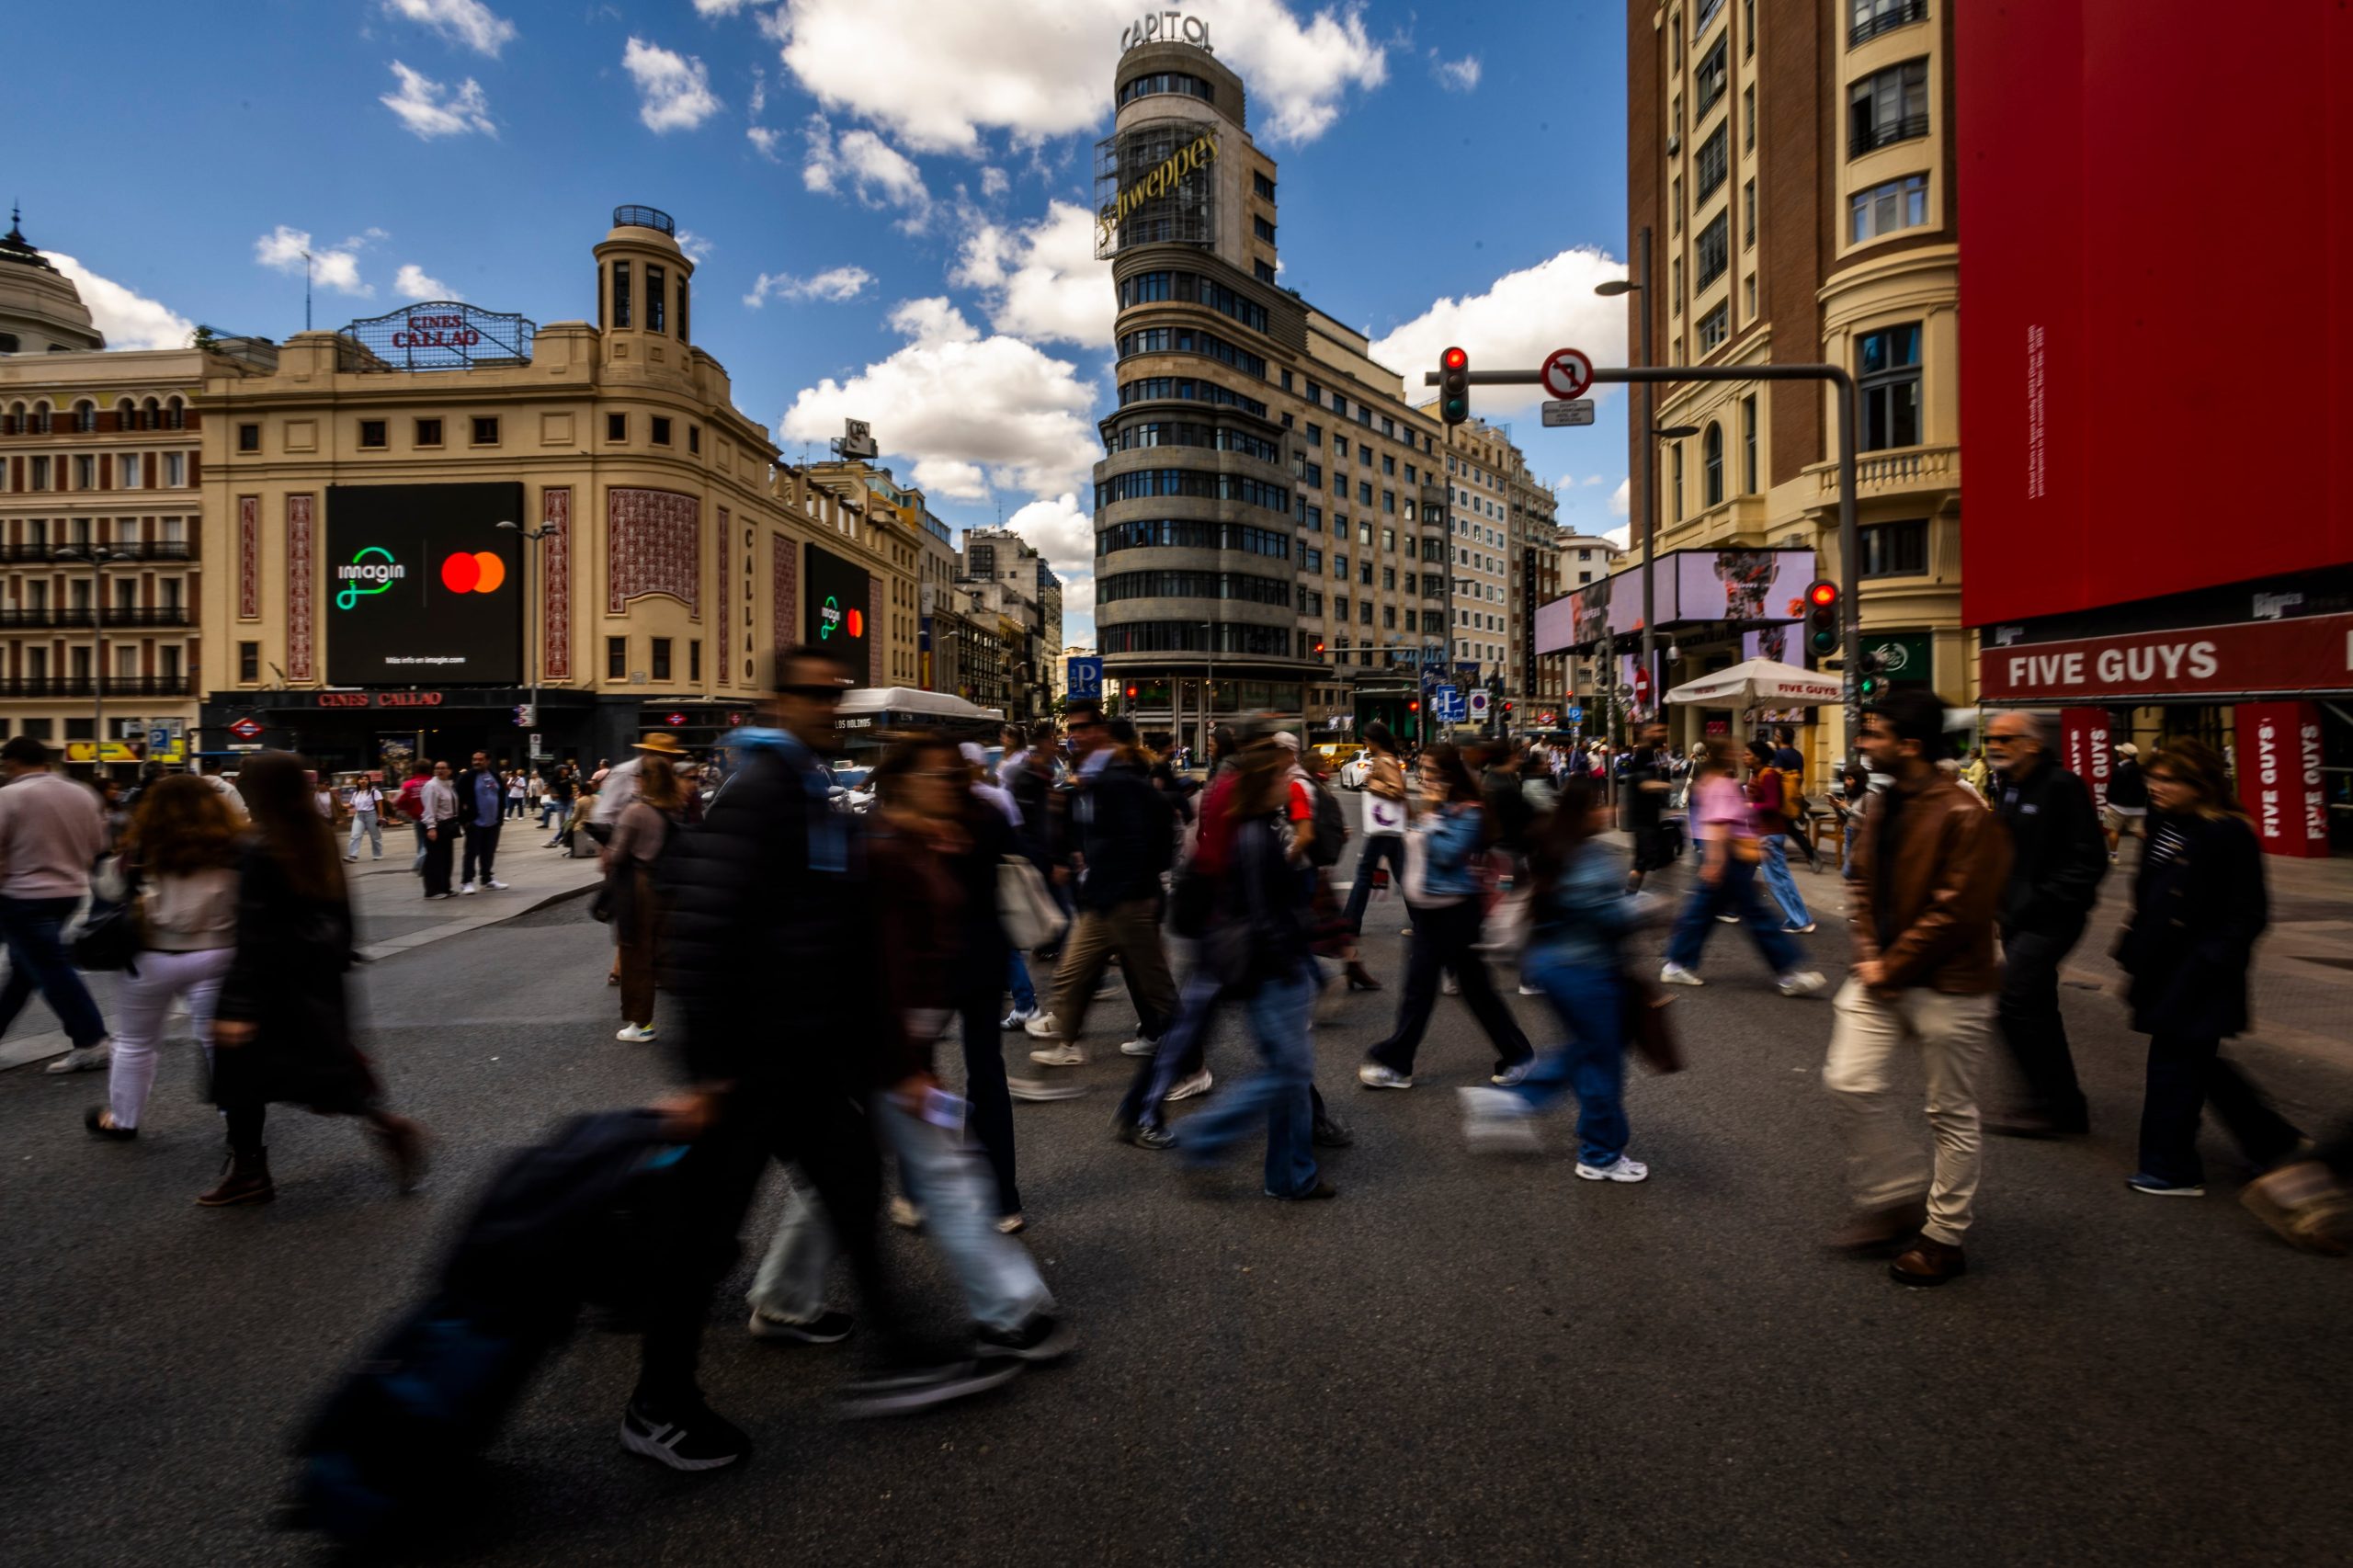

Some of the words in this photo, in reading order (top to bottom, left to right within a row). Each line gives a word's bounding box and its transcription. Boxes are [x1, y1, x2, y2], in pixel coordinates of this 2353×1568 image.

[1120, 11, 1214, 53] CAPITOL
[1098, 127, 1220, 248] Schweppes
[392, 329, 479, 347] CALLAO
[409, 315, 461, 328] CINES
[338, 564, 405, 584] imagin
[745, 528, 753, 678] CALLAO
[1076, 664, 1097, 693] P
[2009, 653, 2085, 687] FIVE
[2097, 641, 2218, 684] GUYS
[318, 693, 369, 707] CINES
[378, 692, 442, 706] CALLAO
[1779, 683, 1802, 693] FIVE
[1805, 685, 1837, 696] GUYS
[835, 720, 846, 729] LOS
[2090, 728, 2109, 778] GUYS
[2258, 724, 2277, 784] GUYS
[2301, 724, 2322, 784] GUYS
[2262, 790, 2279, 837] FIVE
[2305, 790, 2326, 839] FIVE
